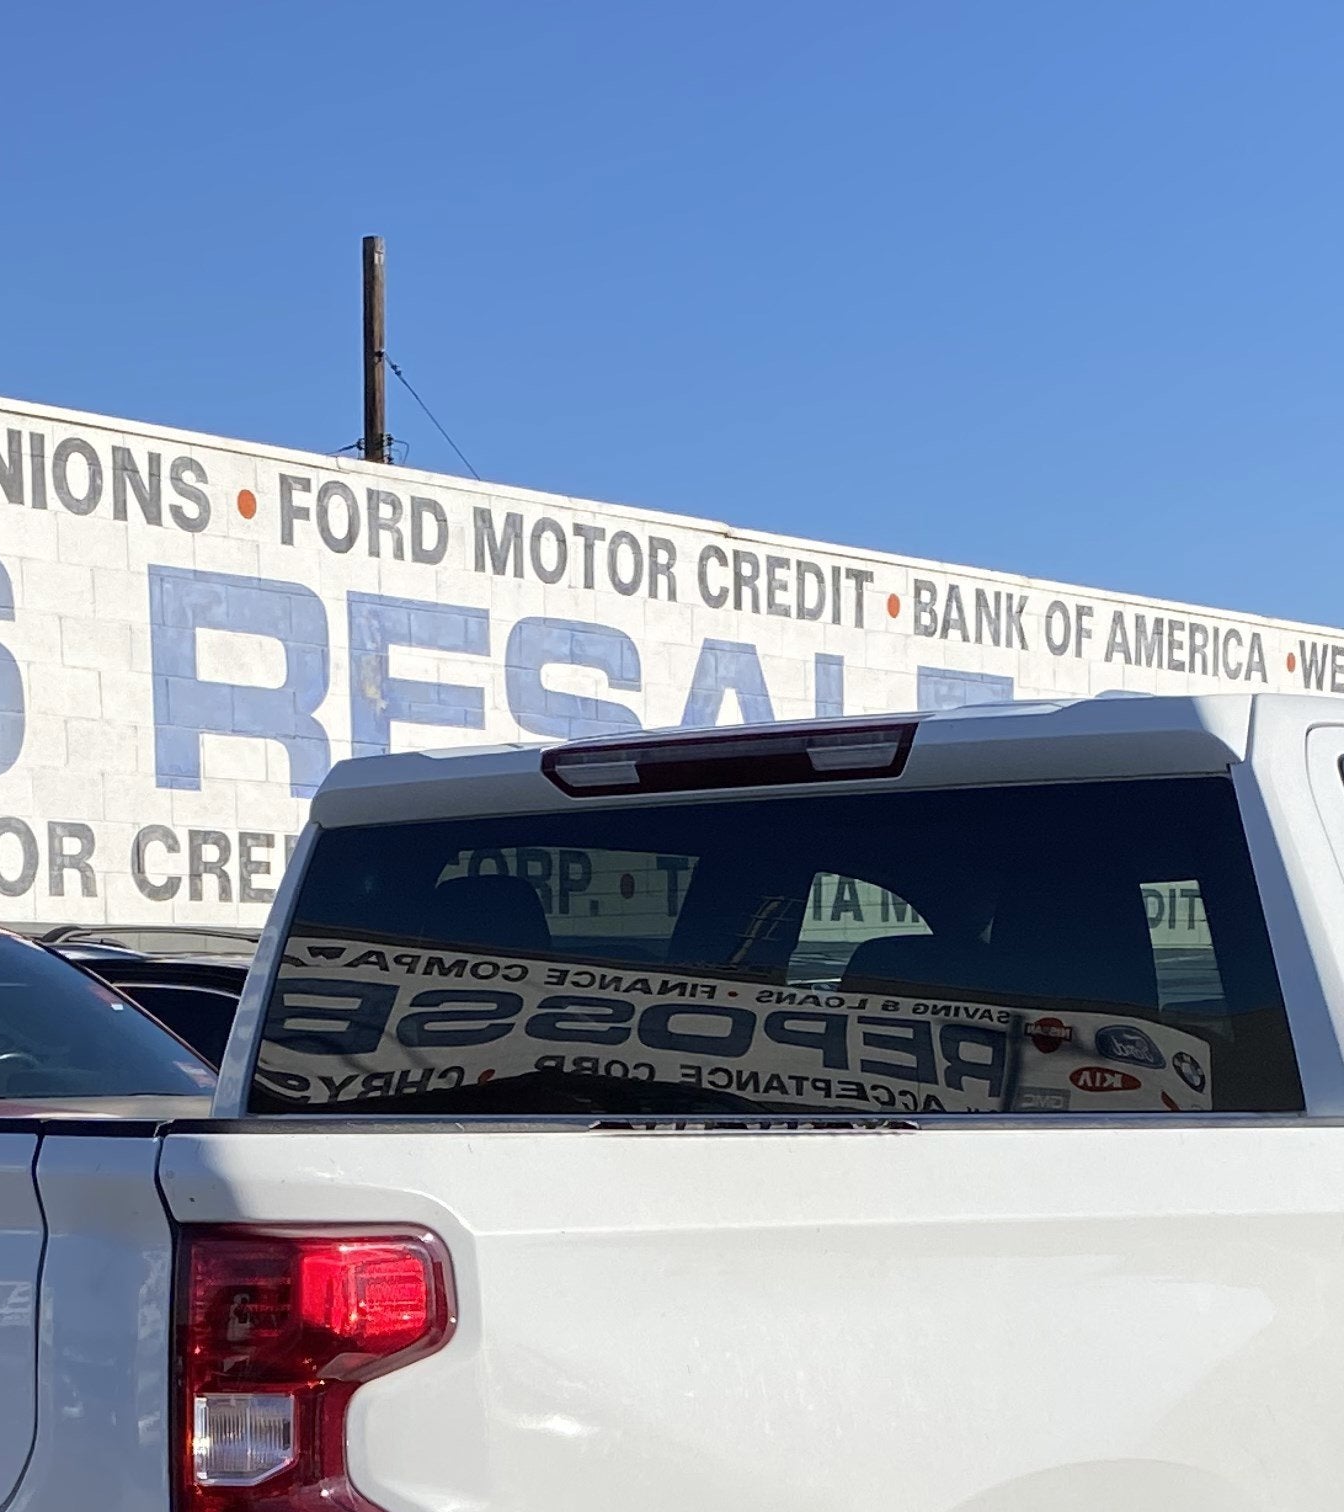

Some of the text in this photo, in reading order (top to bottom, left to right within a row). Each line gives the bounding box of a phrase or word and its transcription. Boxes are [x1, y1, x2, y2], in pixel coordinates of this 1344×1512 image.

[279, 473, 449, 565] FORD
[474, 507, 677, 602] MOTOR
[698, 544, 874, 629] CREDIT
[913, 578, 1029, 650] BANK
[1045, 599, 1094, 658] OF
[1104, 610, 1268, 683] AMERICA
[130, 824, 299, 904] CRE
